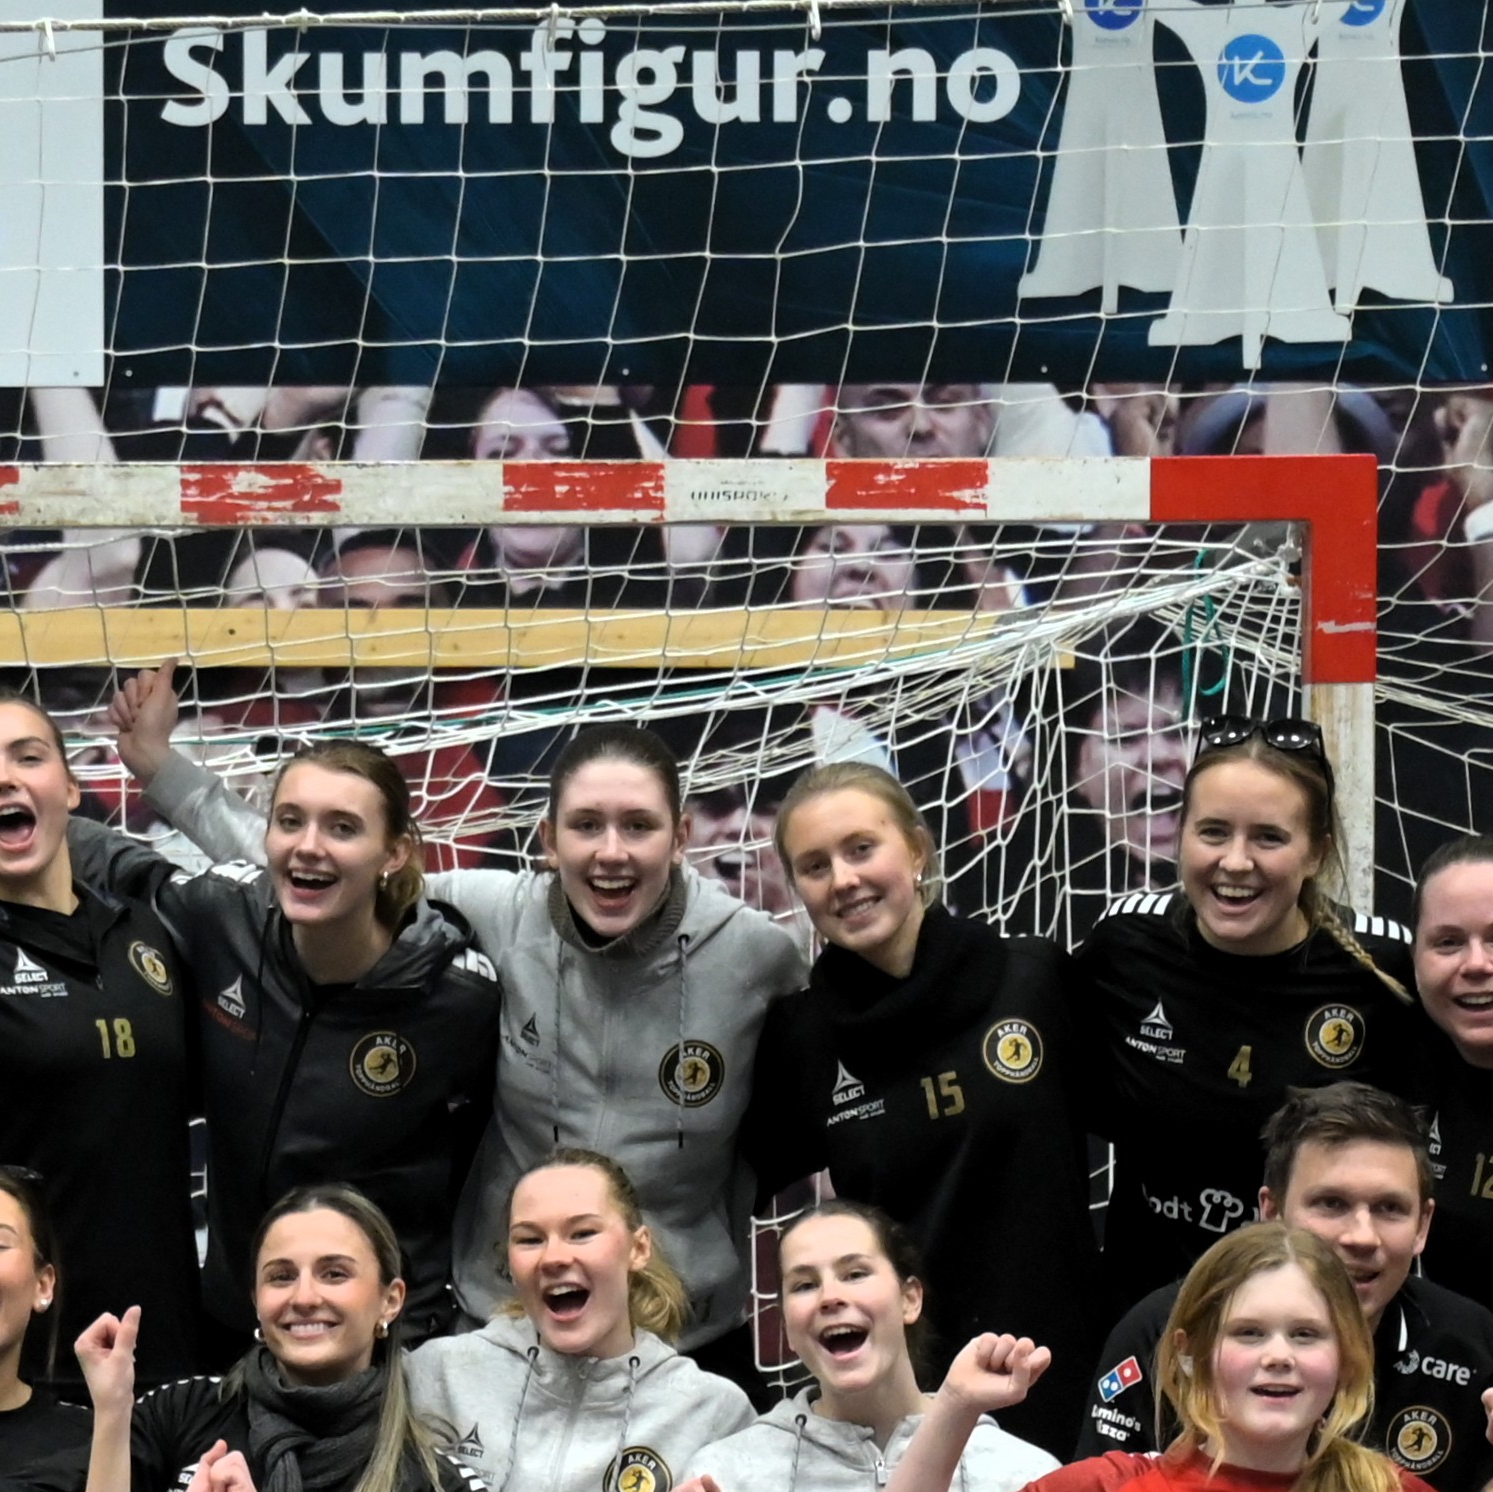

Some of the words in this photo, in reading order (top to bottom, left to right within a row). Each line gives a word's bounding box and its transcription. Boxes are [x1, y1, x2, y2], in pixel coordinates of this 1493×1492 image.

[160, 17, 1022, 159] Skumfigur.no
[14, 971, 48, 983] SELECT
[218, 996, 245, 1019] SELECT
[1324, 1008, 1354, 1022] AKER
[96, 1017, 136, 1059] 18
[997, 1023, 1028, 1039] AKER
[1140, 1024, 1173, 1041] SELECT
[1227, 1045, 1252, 1089] 4
[833, 1084, 865, 1106] SELECT
[920, 1071, 965, 1120] 15
[1421, 1356, 1471, 1386] care
[1404, 1411, 1438, 1425] AKER
[1096, 1420, 1131, 1441] izza
[457, 1445, 484, 1458] SELECT
[628, 1454, 656, 1470] AKER
